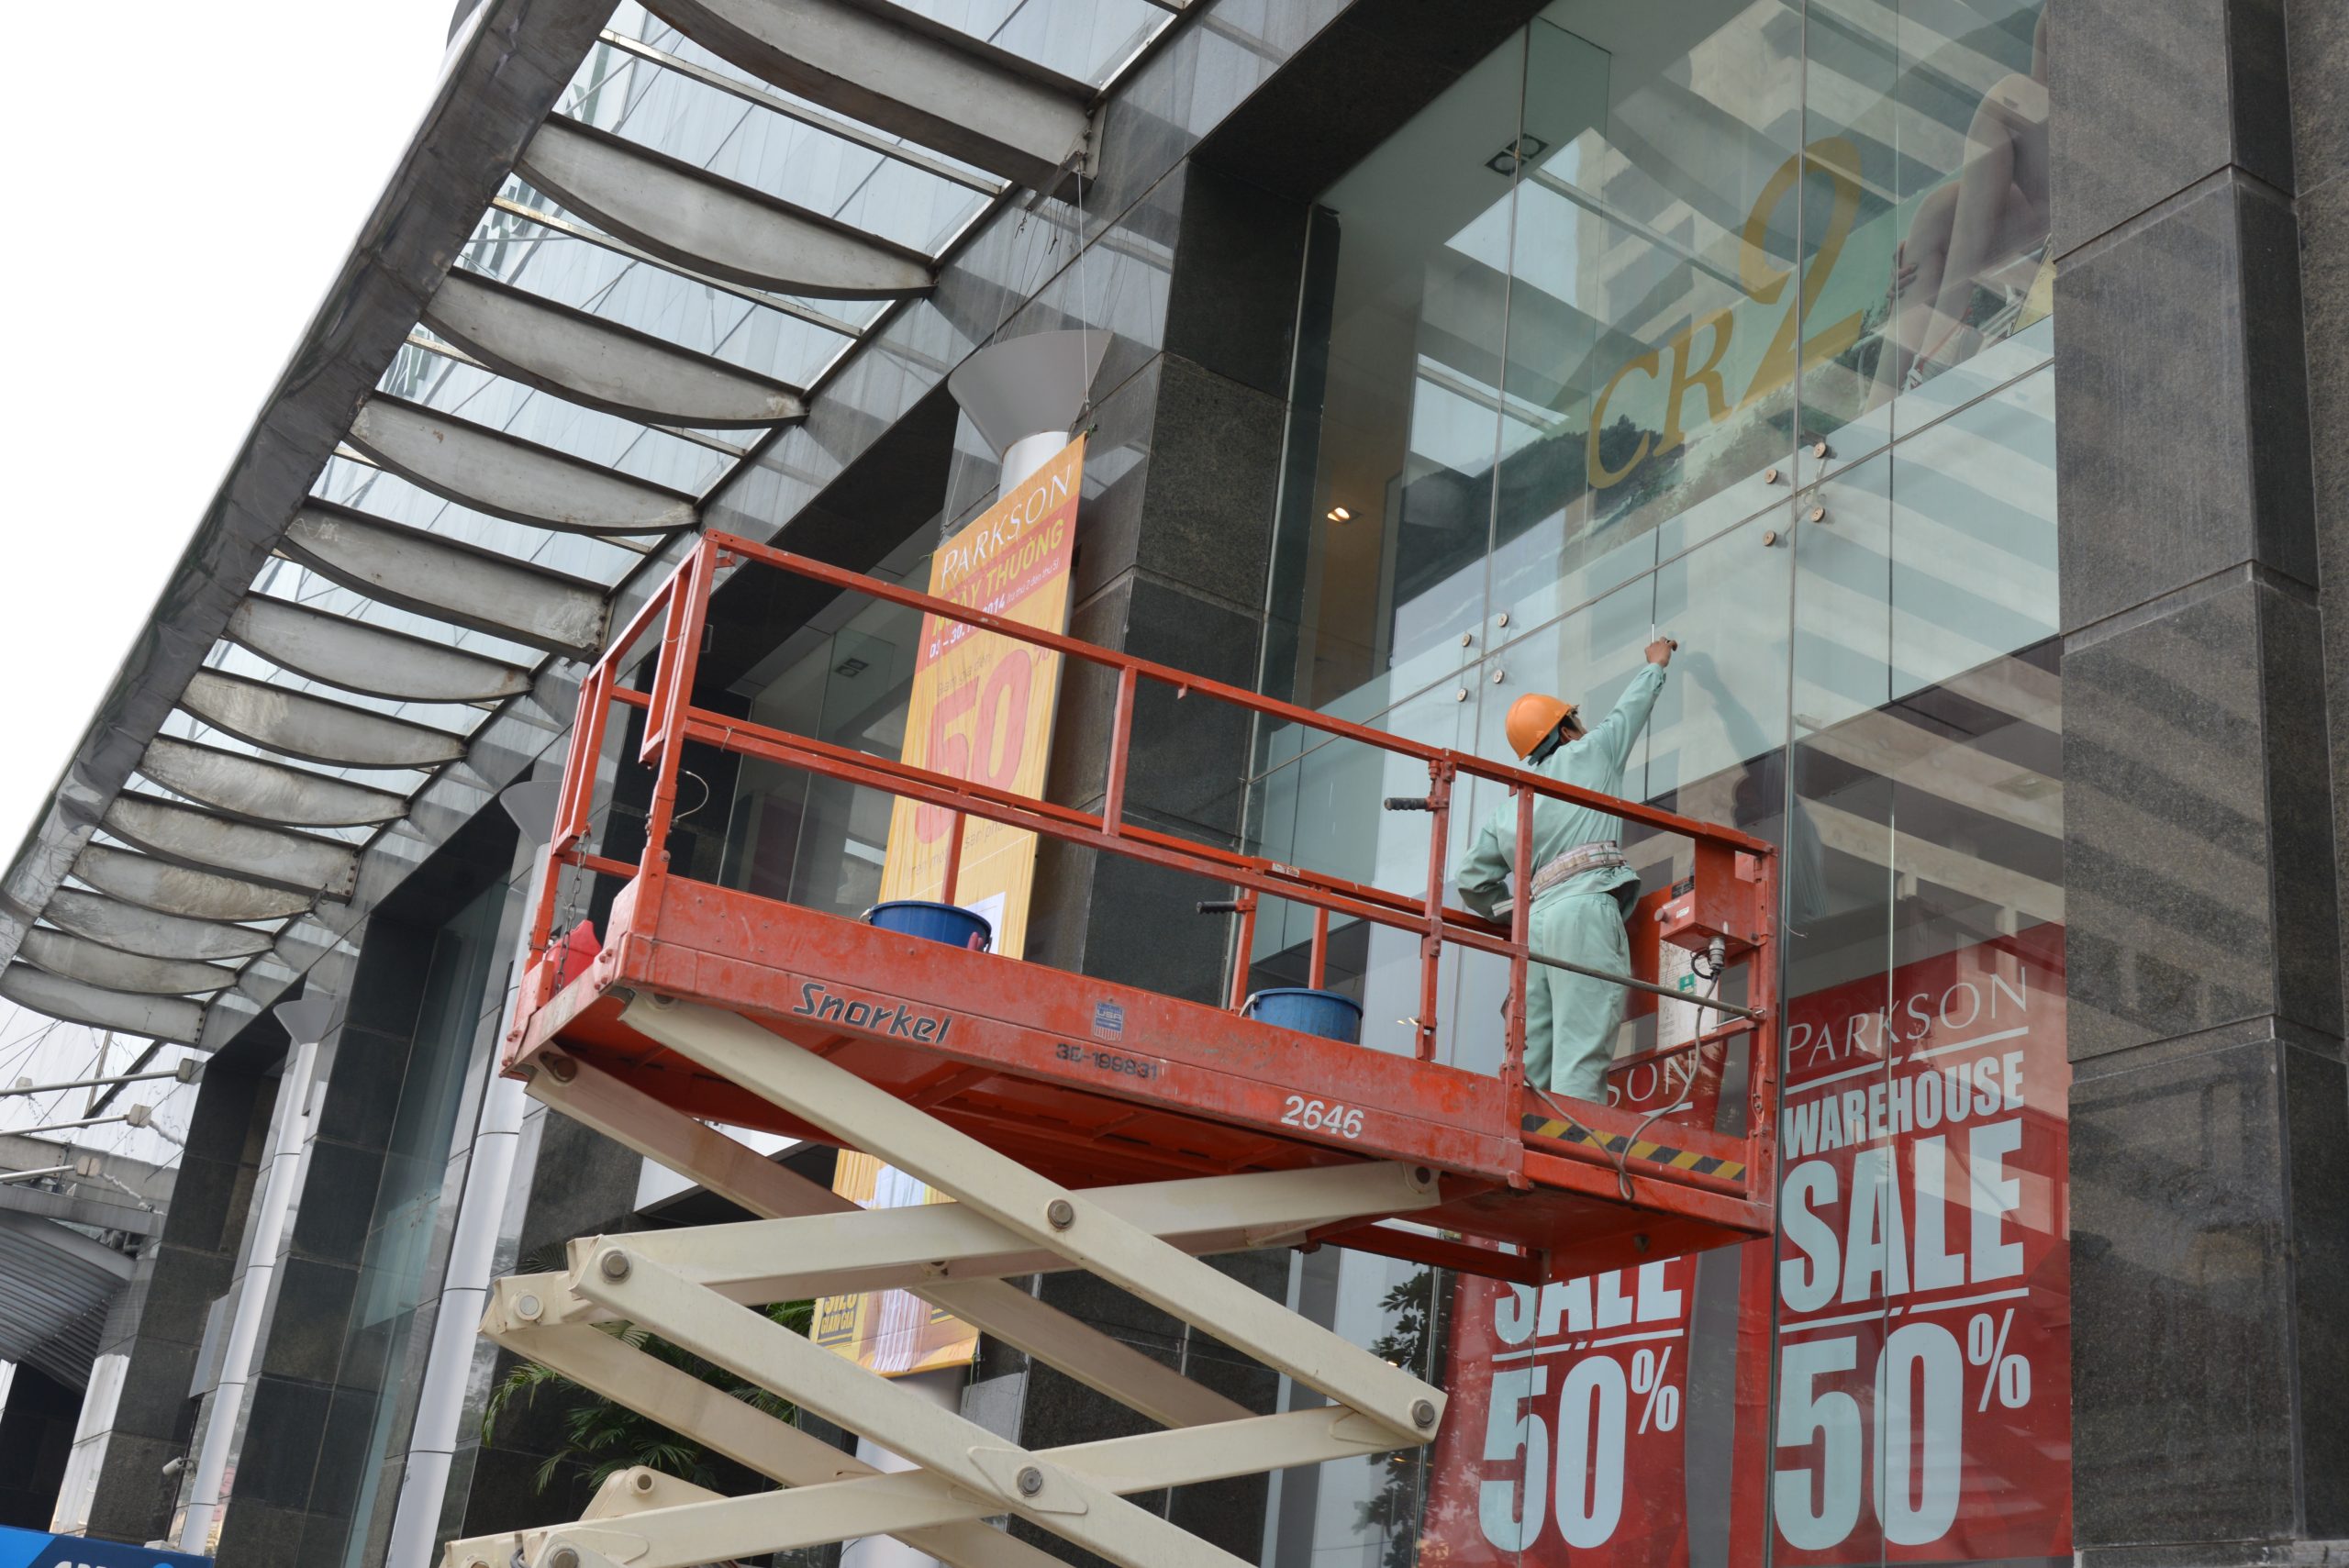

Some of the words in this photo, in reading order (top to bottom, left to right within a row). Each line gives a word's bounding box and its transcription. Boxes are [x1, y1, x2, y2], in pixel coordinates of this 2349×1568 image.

[941, 463, 1072, 591] PARKSON
[793, 983, 952, 1044] Snorkel
[1097, 1009, 1122, 1021] USA
[1785, 965, 2027, 1073] PARKSON
[1281, 1095, 1364, 1139] 2646
[1783, 1051, 2024, 1160] WAREHOUSE
[1778, 1118, 2024, 1314] SALE
[1478, 1346, 1680, 1551] 50%
[1774, 1307, 2032, 1551] 50%
